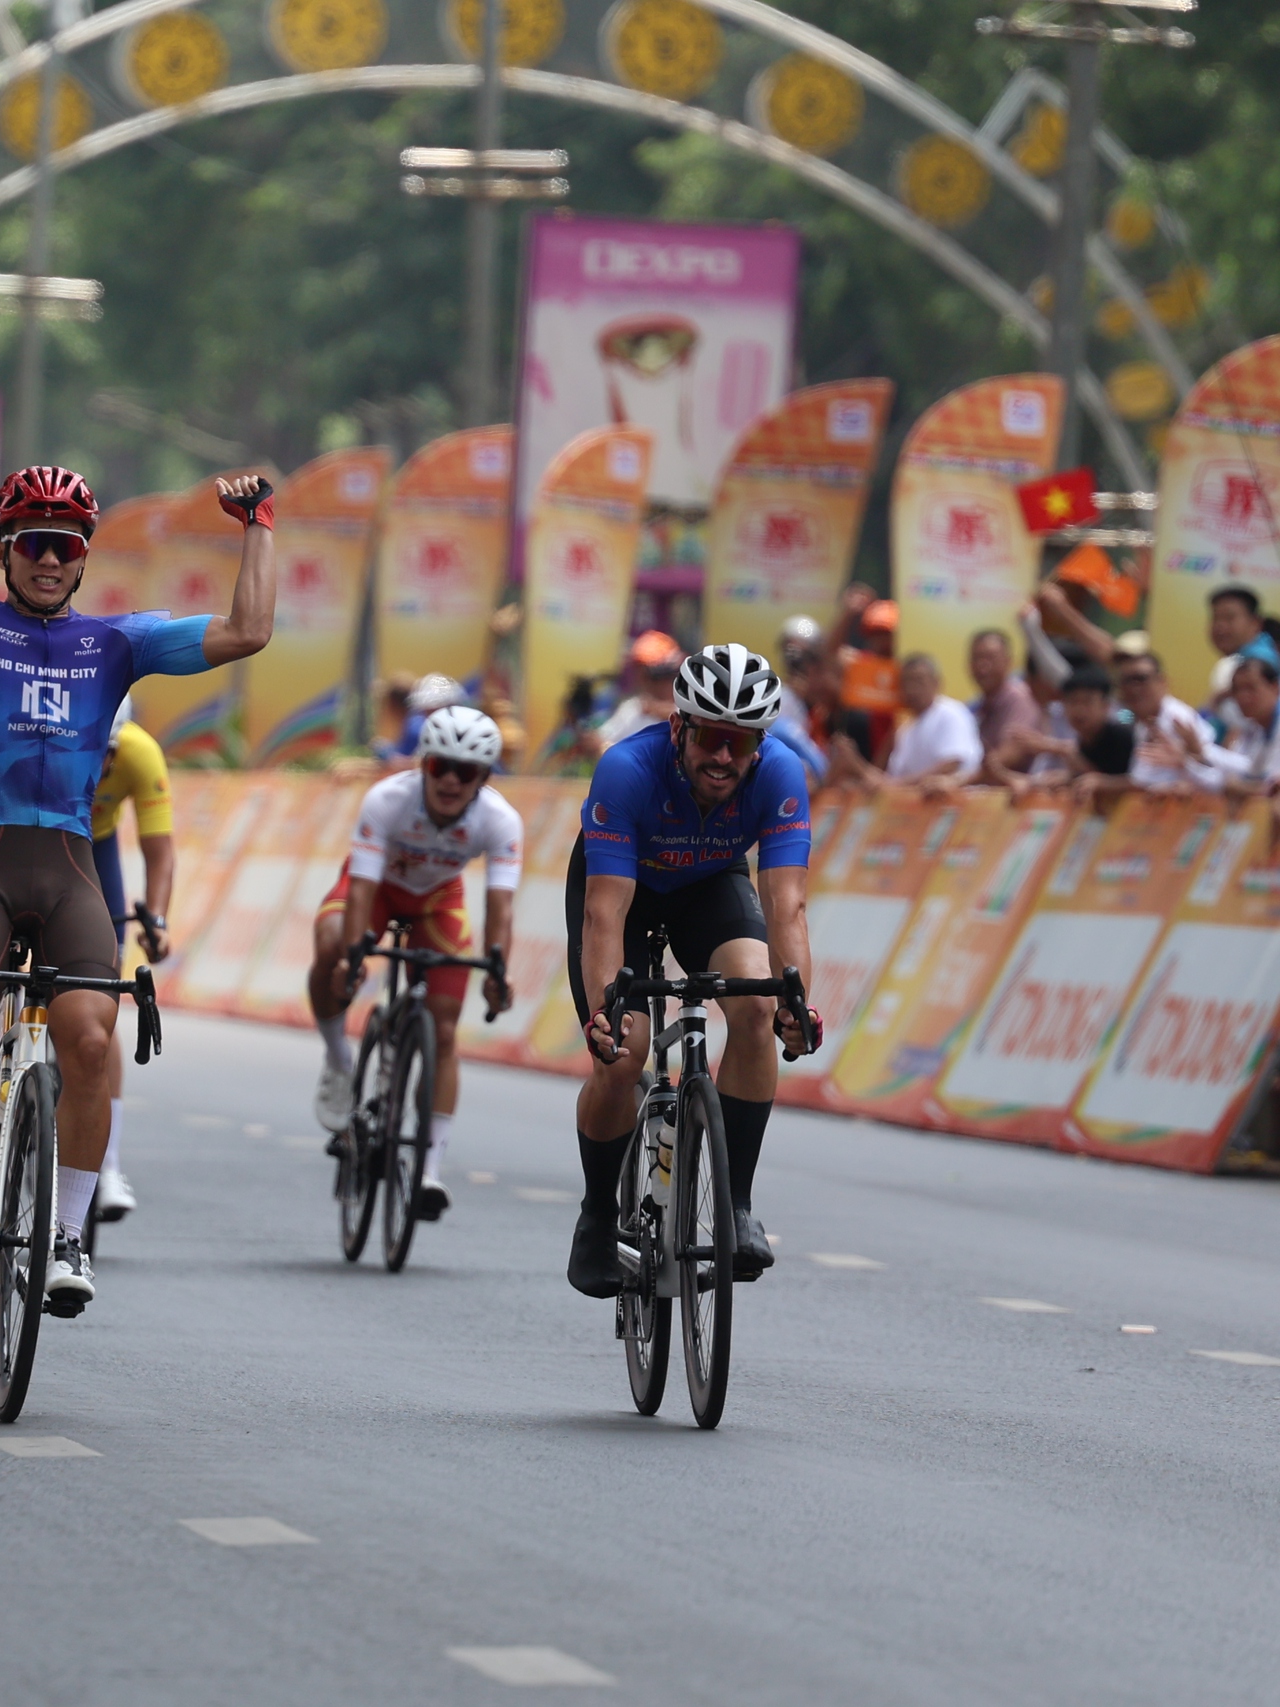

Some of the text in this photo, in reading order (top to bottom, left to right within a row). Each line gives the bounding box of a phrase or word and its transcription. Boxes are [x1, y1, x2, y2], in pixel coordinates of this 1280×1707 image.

[74, 647, 102, 656] motive
[15, 662, 35, 675] CHI
[38, 666, 68, 679] MINH
[70, 667, 98, 679] CITY
[7, 722, 79, 738] NEW GROUP
